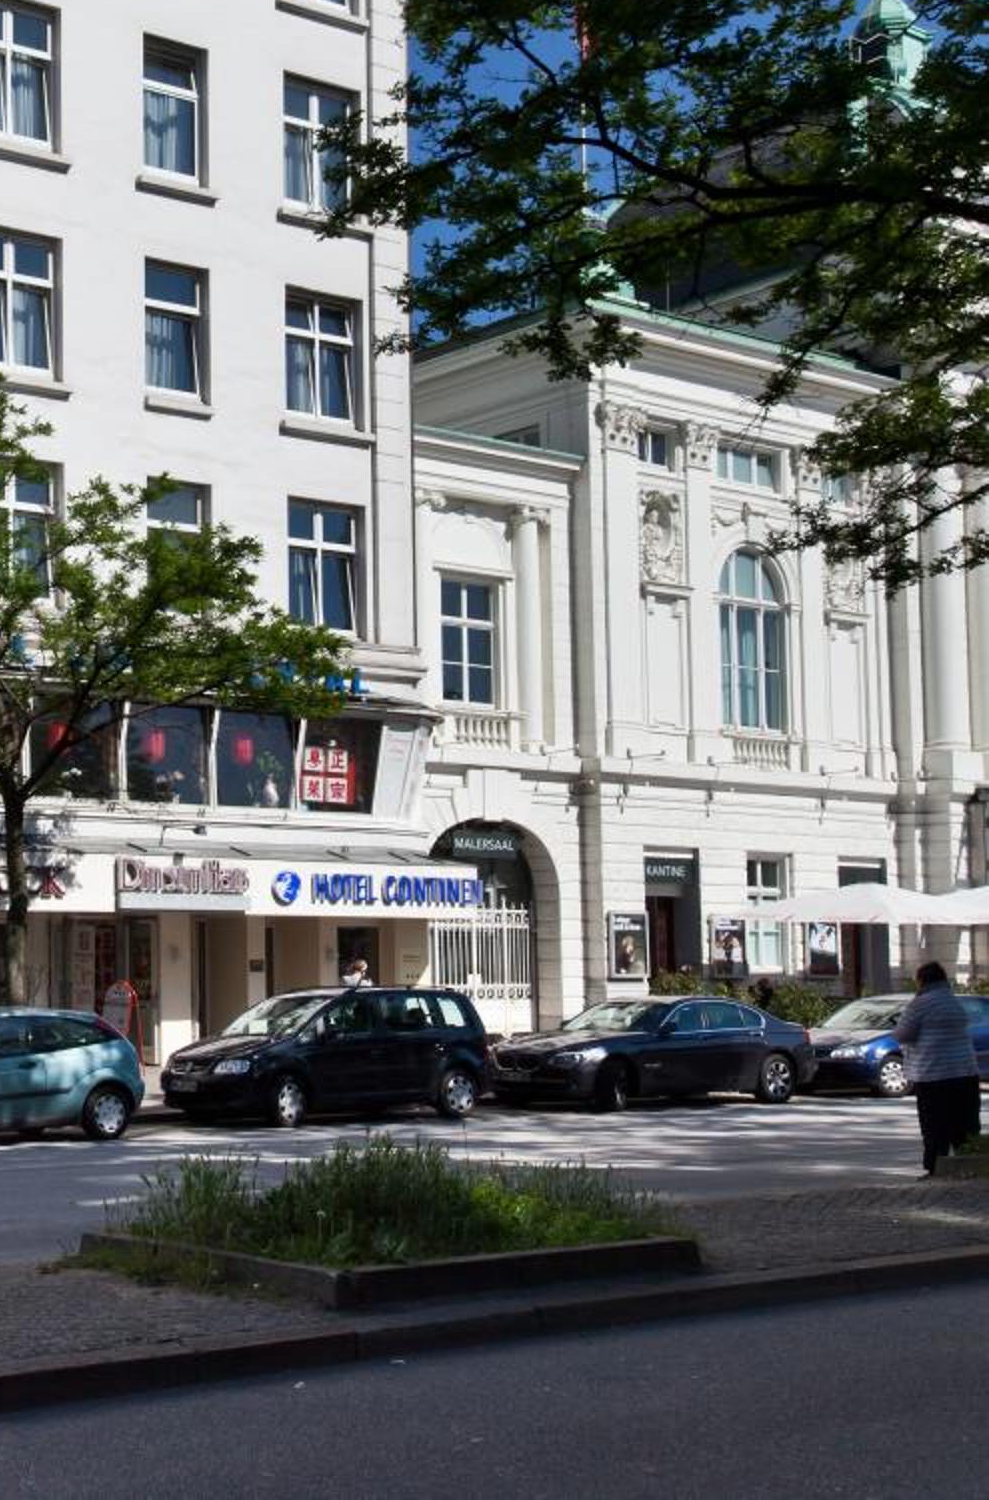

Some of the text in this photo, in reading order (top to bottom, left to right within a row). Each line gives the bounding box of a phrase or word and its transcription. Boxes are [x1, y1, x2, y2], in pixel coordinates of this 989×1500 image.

[453, 836, 515, 852] MALERSAAL
[646, 864, 687, 878] KANTINE
[312, 873, 378, 904] HOTEL
